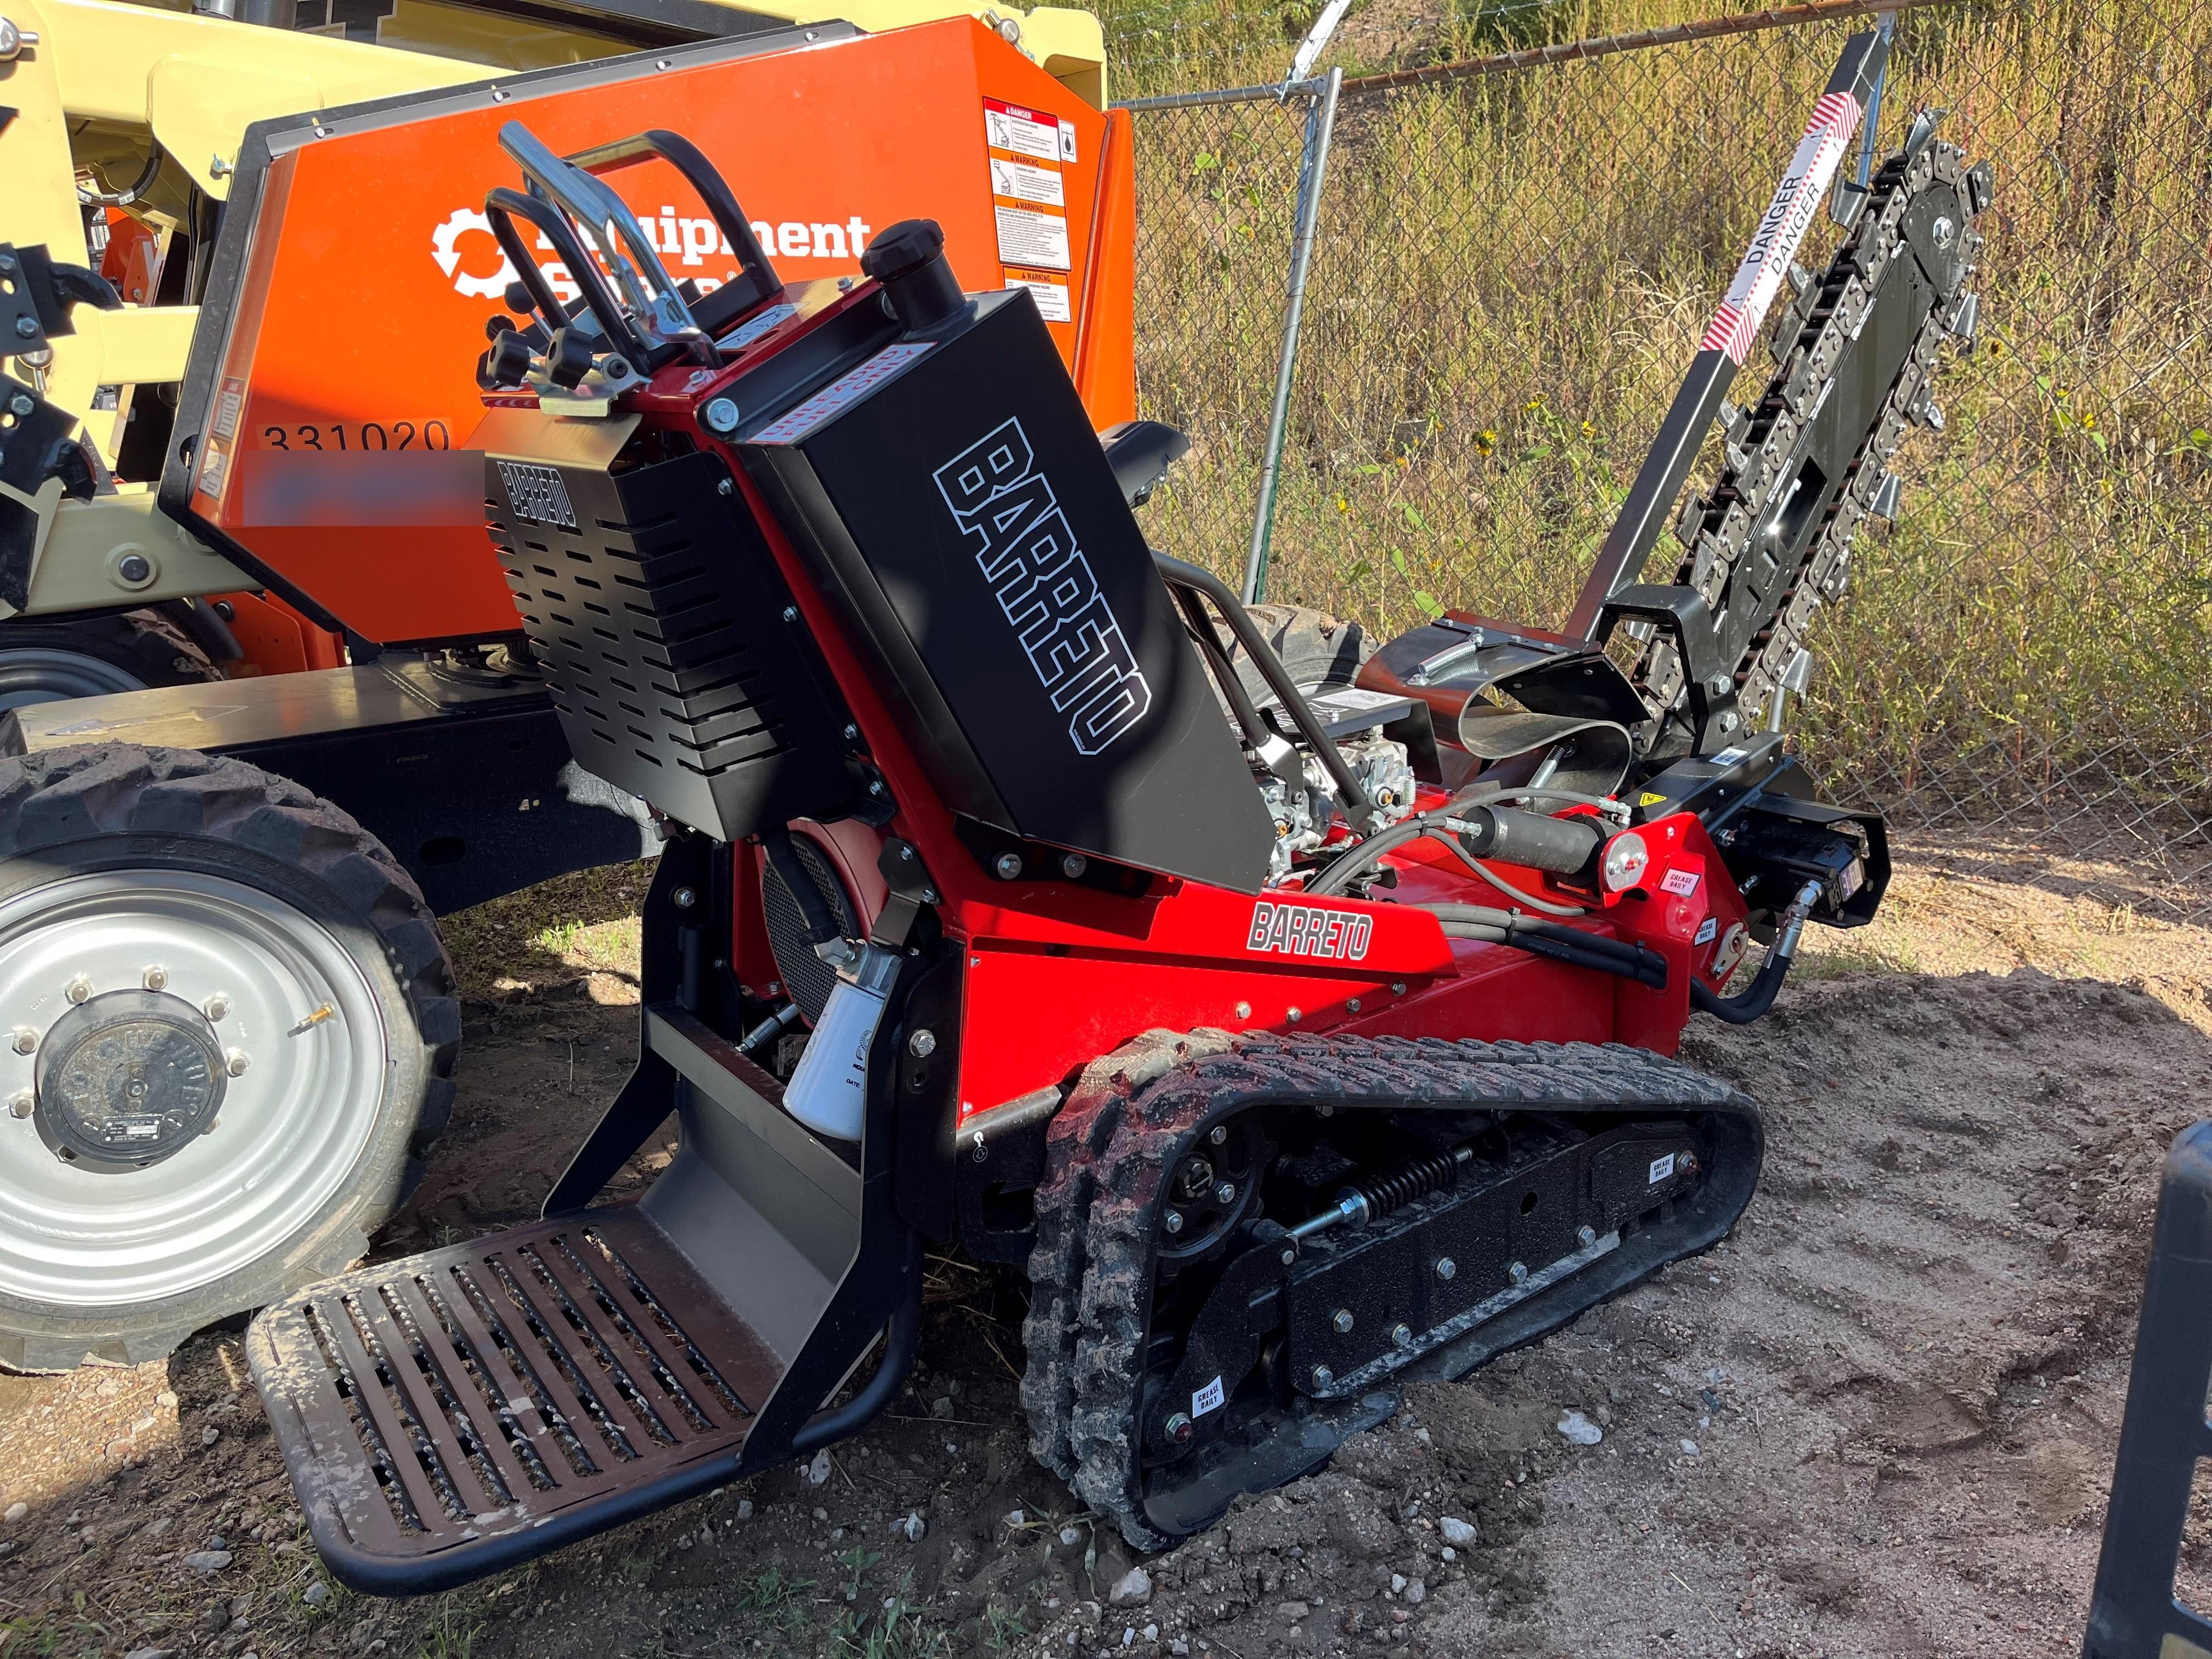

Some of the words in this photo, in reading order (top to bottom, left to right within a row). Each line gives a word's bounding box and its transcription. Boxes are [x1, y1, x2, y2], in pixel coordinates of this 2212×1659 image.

[1010, 107, 1032, 120] DANGER
[1014, 156, 1039, 167] WARNING
[1019, 202, 1044, 213] WARNING
[1746, 176, 1802, 264] DANGER
[1771, 183, 1819, 276] DANGER
[1026, 272, 1051, 282] WARNING
[764, 350, 899, 436] UNLEADED
[782, 394, 850, 437] FUEL
[852, 349, 915, 391] ONLY
[264, 420, 449, 450] 331020
[496, 461, 576, 527] BARRETO
[933, 415, 1152, 755] BARRETO
[1669, 881, 1687, 890] DAILY
[1670, 874, 1693, 884] GREASE
[1246, 901, 1373, 961] BARRETO
[1700, 931, 1711, 939] DAILY
[1654, 1158, 1671, 1171] GREASE
[1655, 1167, 1668, 1178] DAILY
[1198, 1383, 1219, 1402] GREASE
[1200, 1395, 1217, 1409] DAILY
